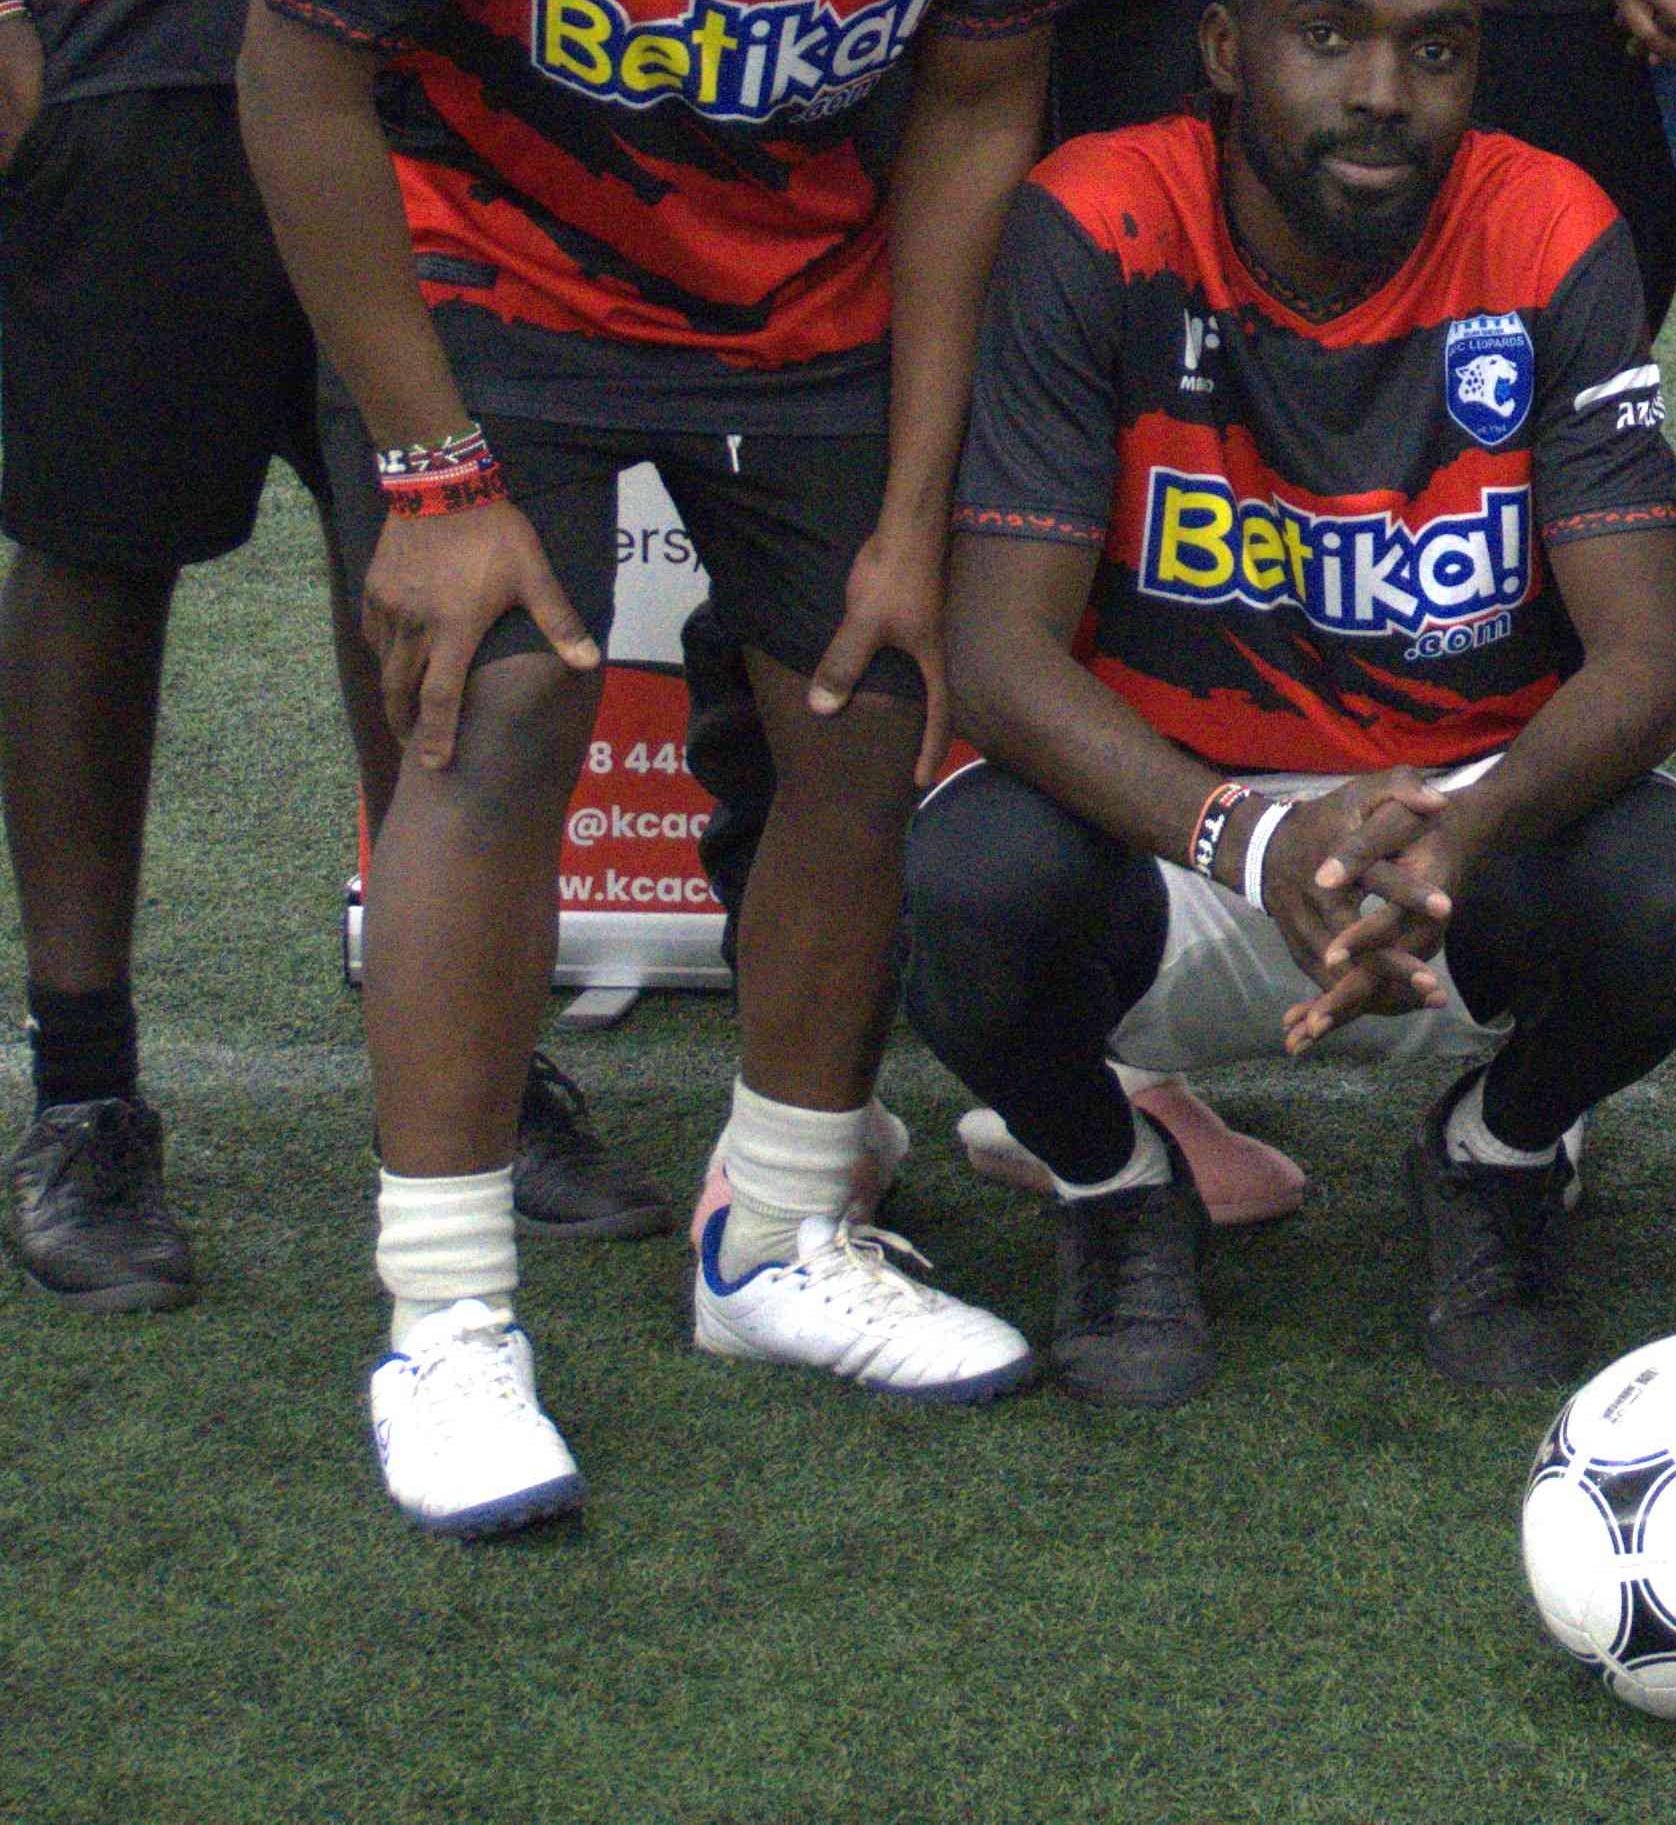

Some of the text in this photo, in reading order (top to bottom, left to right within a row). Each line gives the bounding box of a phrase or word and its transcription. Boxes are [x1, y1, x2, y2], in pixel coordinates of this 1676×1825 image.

[1156, 484, 1522, 622] Betika!
[1403, 612, 1513, 662] .com
[624, 741, 690, 774] 44
[558, 869, 724, 903] w.kcac
